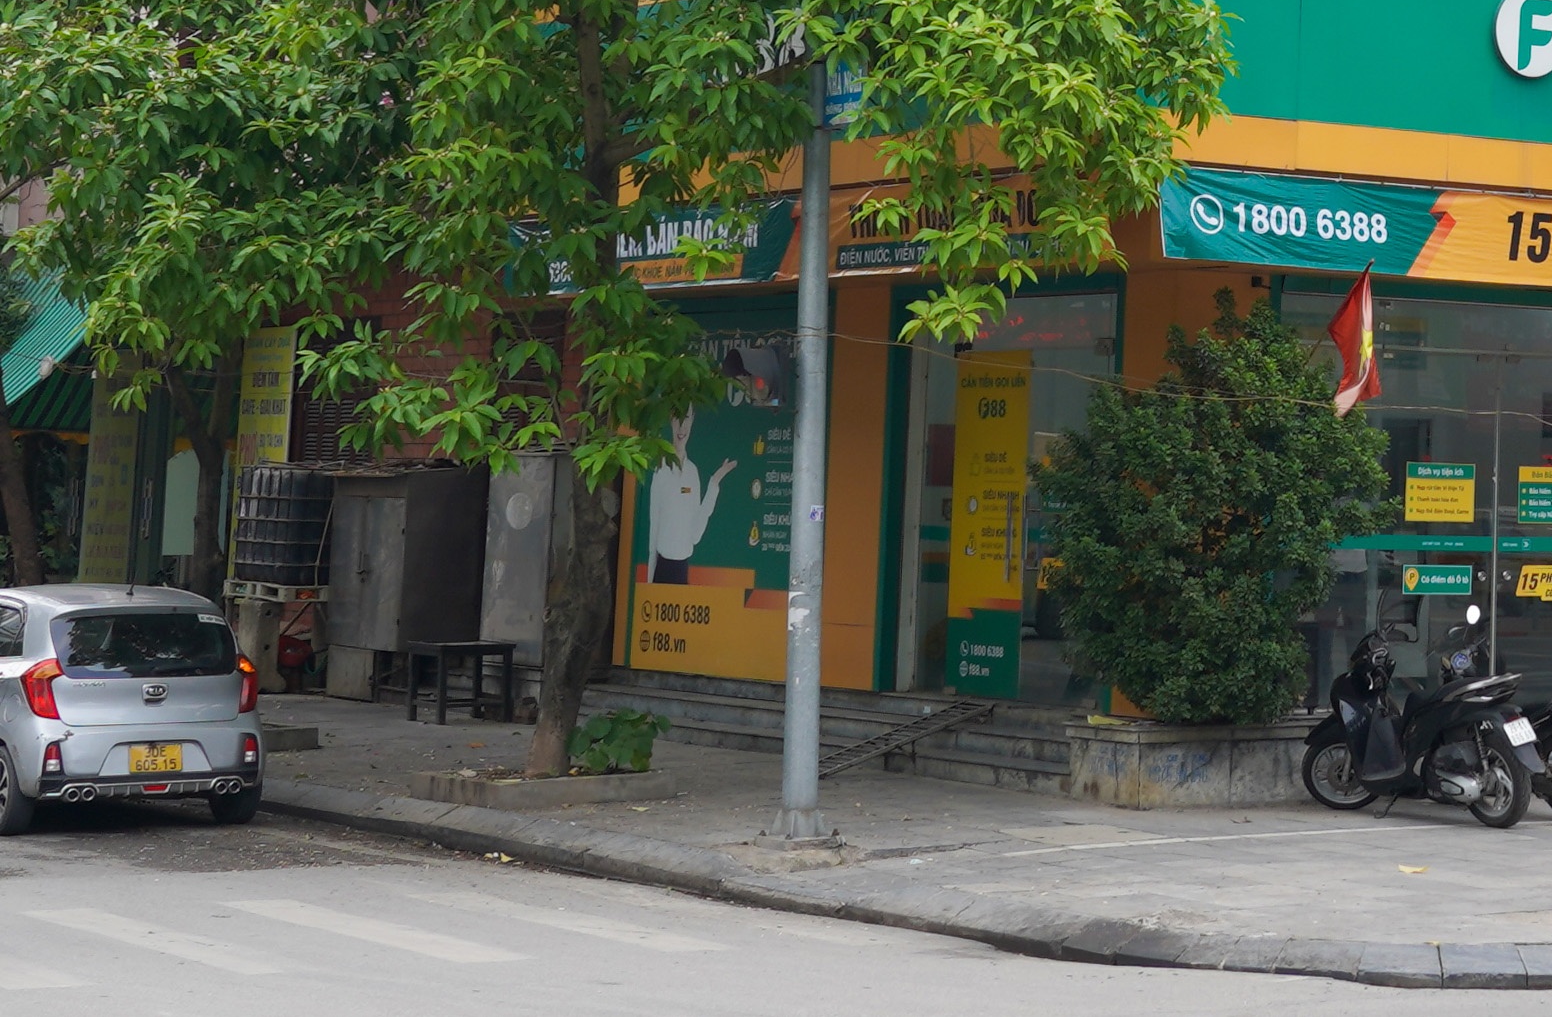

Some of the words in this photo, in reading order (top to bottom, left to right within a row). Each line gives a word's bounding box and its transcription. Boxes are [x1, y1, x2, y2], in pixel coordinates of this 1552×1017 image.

[1233, 201, 1307, 237] 1800
[1316, 208, 1388, 244] 6388
[1507, 209, 1552, 264] 15
[839, 249, 862, 269] ĐIỆN
[1521, 573, 1539, 591] 15
[654, 602, 681, 622] 1800
[683, 604, 711, 625] 6388
[653, 635, 686, 654] f88.vn
[970, 644, 986, 657] 1800
[986, 645, 1004, 658] 6388
[145, 687, 166, 695] KIA
[135, 759, 177, 772] 605.15
